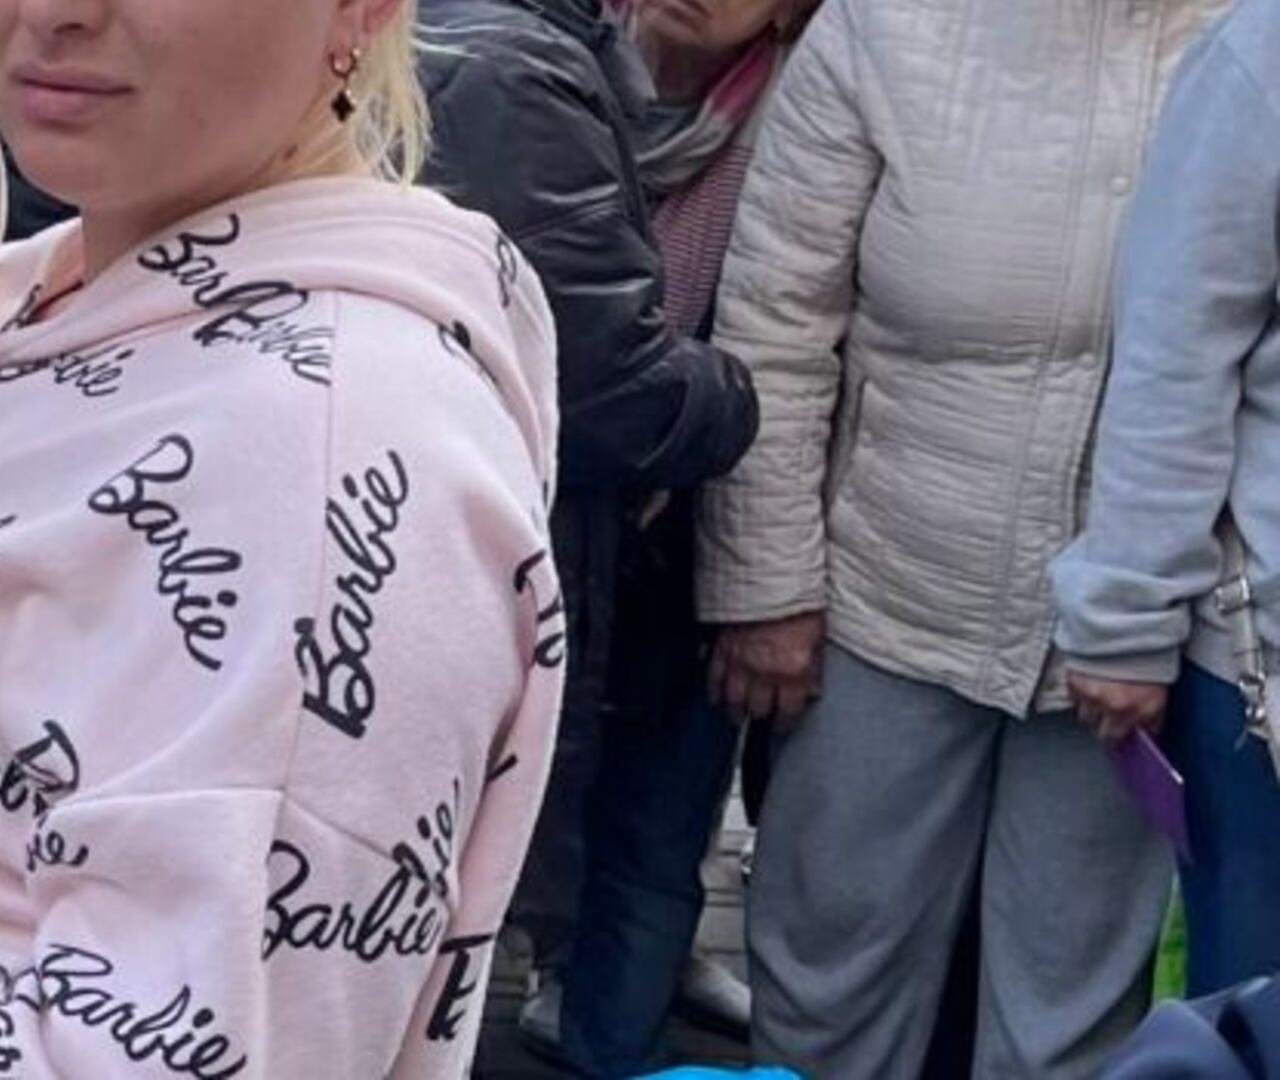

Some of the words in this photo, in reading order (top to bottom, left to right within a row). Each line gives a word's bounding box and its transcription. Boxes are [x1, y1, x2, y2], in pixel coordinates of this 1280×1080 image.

[88, 434, 243, 672] Barbie
[293, 448, 410, 739] Barbie
[262, 840, 440, 962] Barbie
[17, 943, 247, 1080] Barbie
